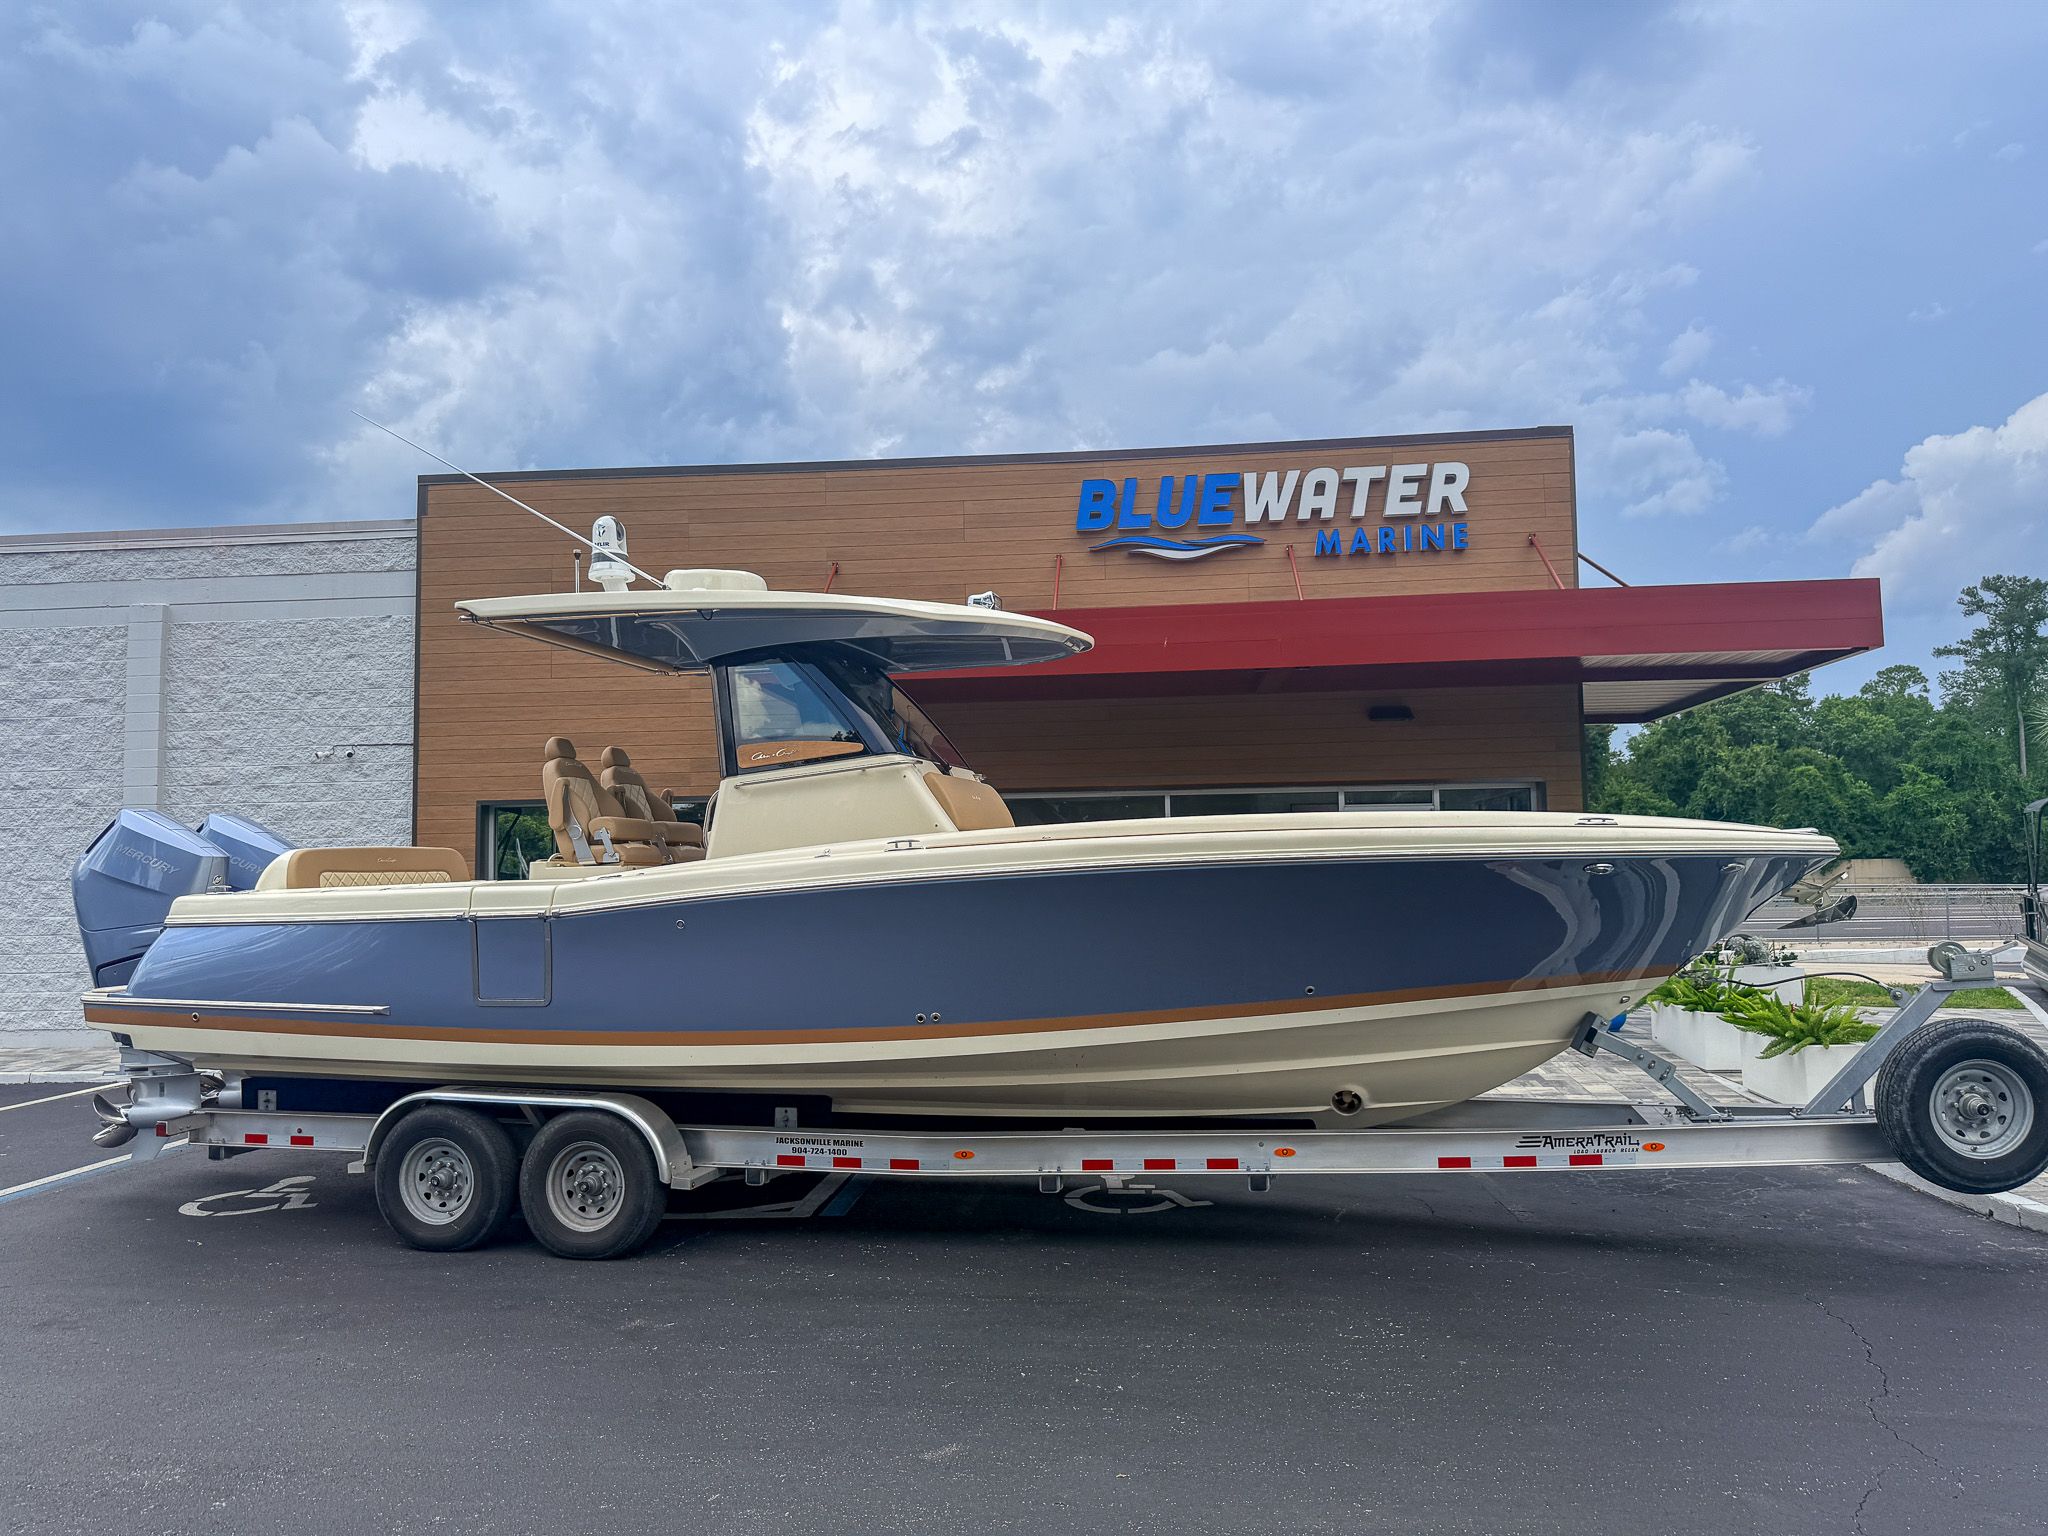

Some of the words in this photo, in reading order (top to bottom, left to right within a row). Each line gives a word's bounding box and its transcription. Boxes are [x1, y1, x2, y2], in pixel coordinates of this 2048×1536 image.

[1314, 522, 1469, 557] MARINE
[115, 843, 183, 875] MERCURY
[230, 855, 263, 873] CURY
[775, 1137, 831, 1146] JACKSONVILLE
[833, 1139, 864, 1147] MARINE
[791, 1146, 847, 1156] 904-724-1400
